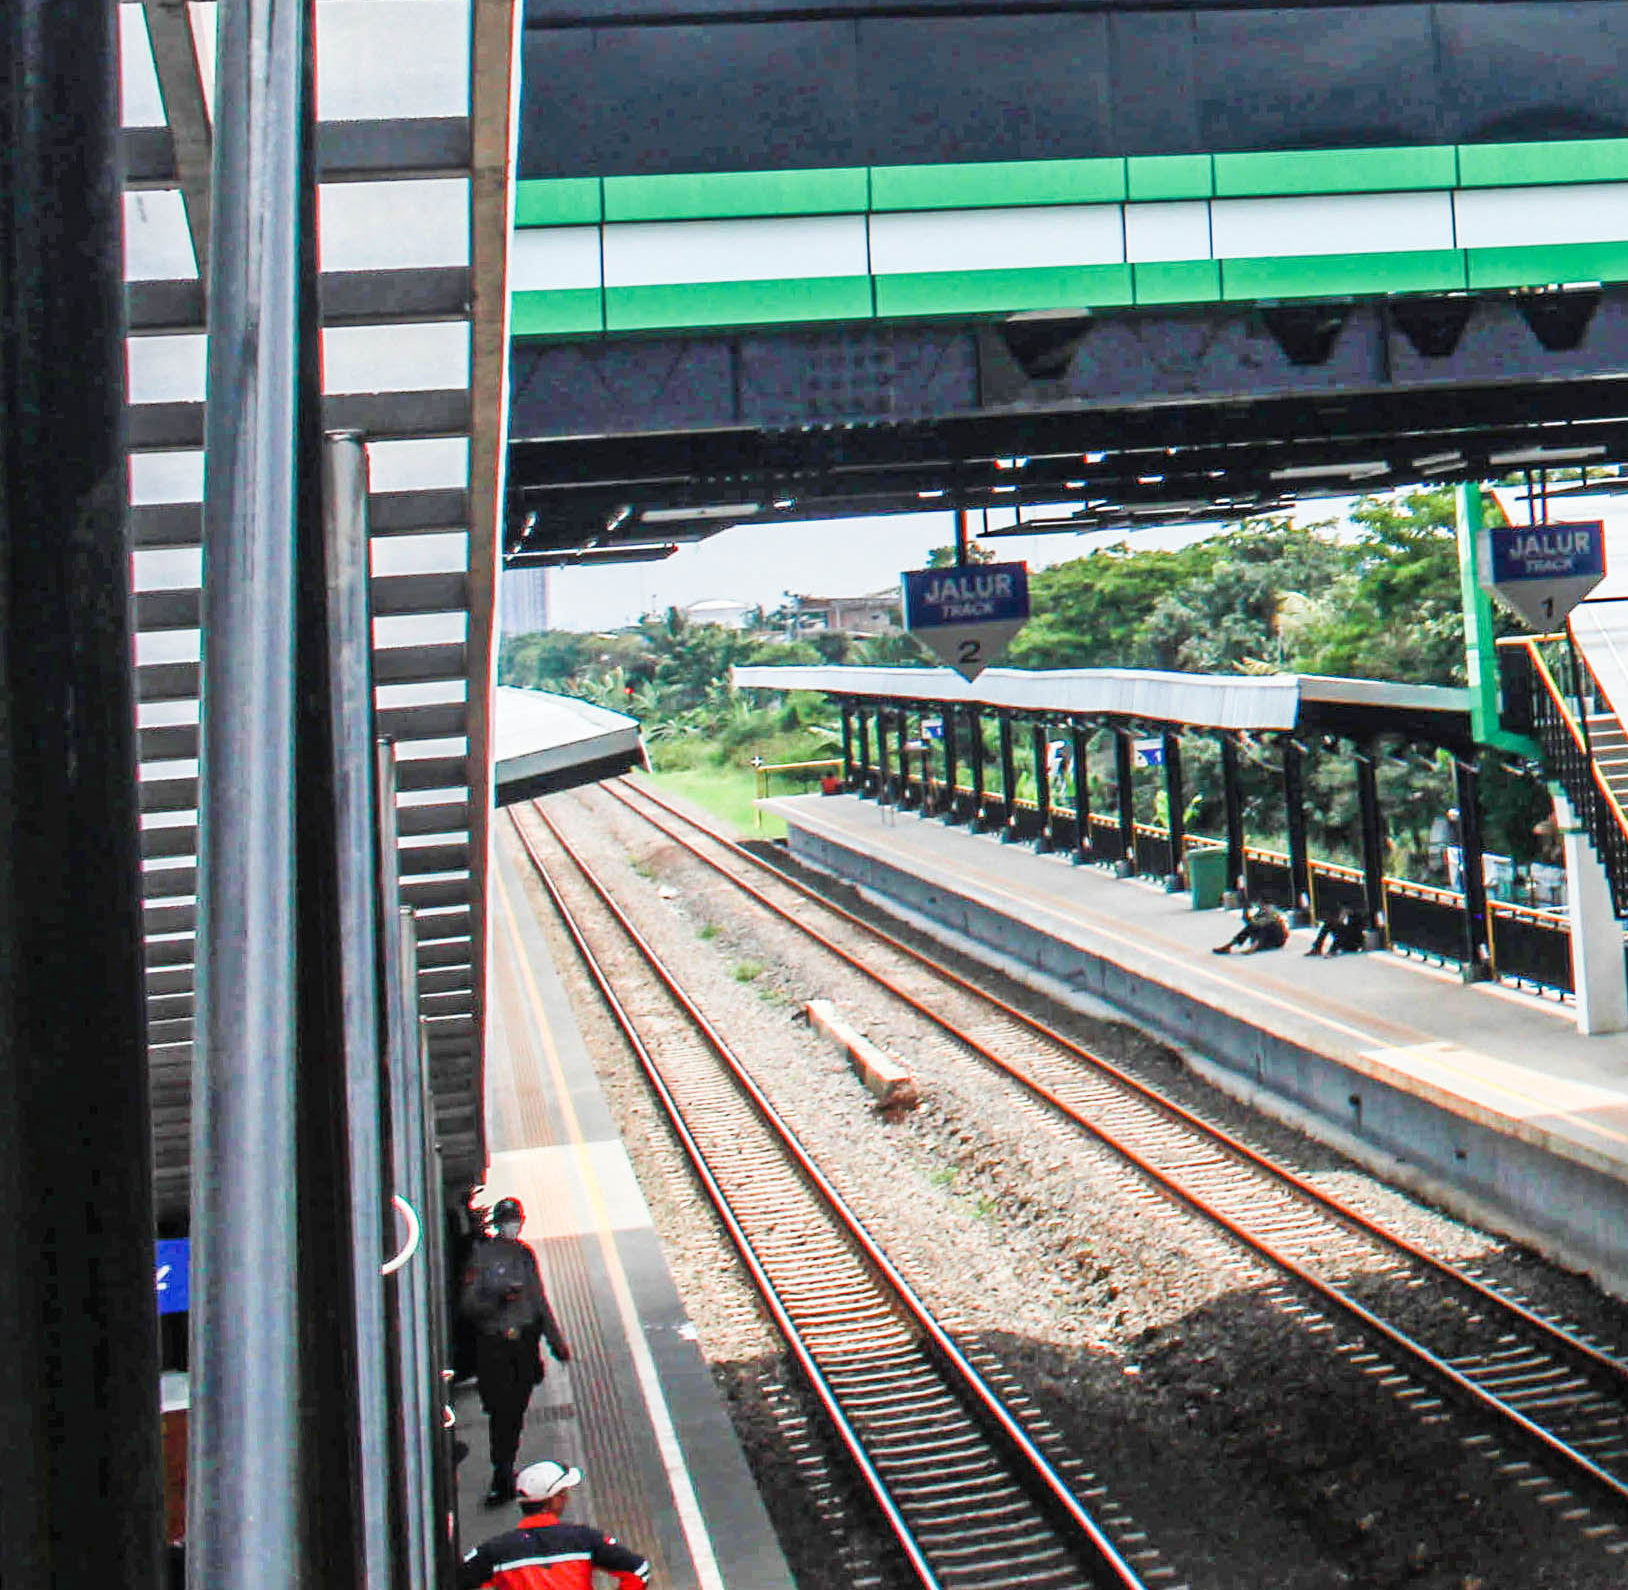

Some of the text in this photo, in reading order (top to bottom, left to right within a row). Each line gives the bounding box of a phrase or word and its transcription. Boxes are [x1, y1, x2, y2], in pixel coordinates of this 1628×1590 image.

[1508, 530, 1592, 560] JALUR
[923, 573, 1013, 605] JALUR
[1539, 596, 1554, 618] 1
[958, 639, 982, 664] 2
